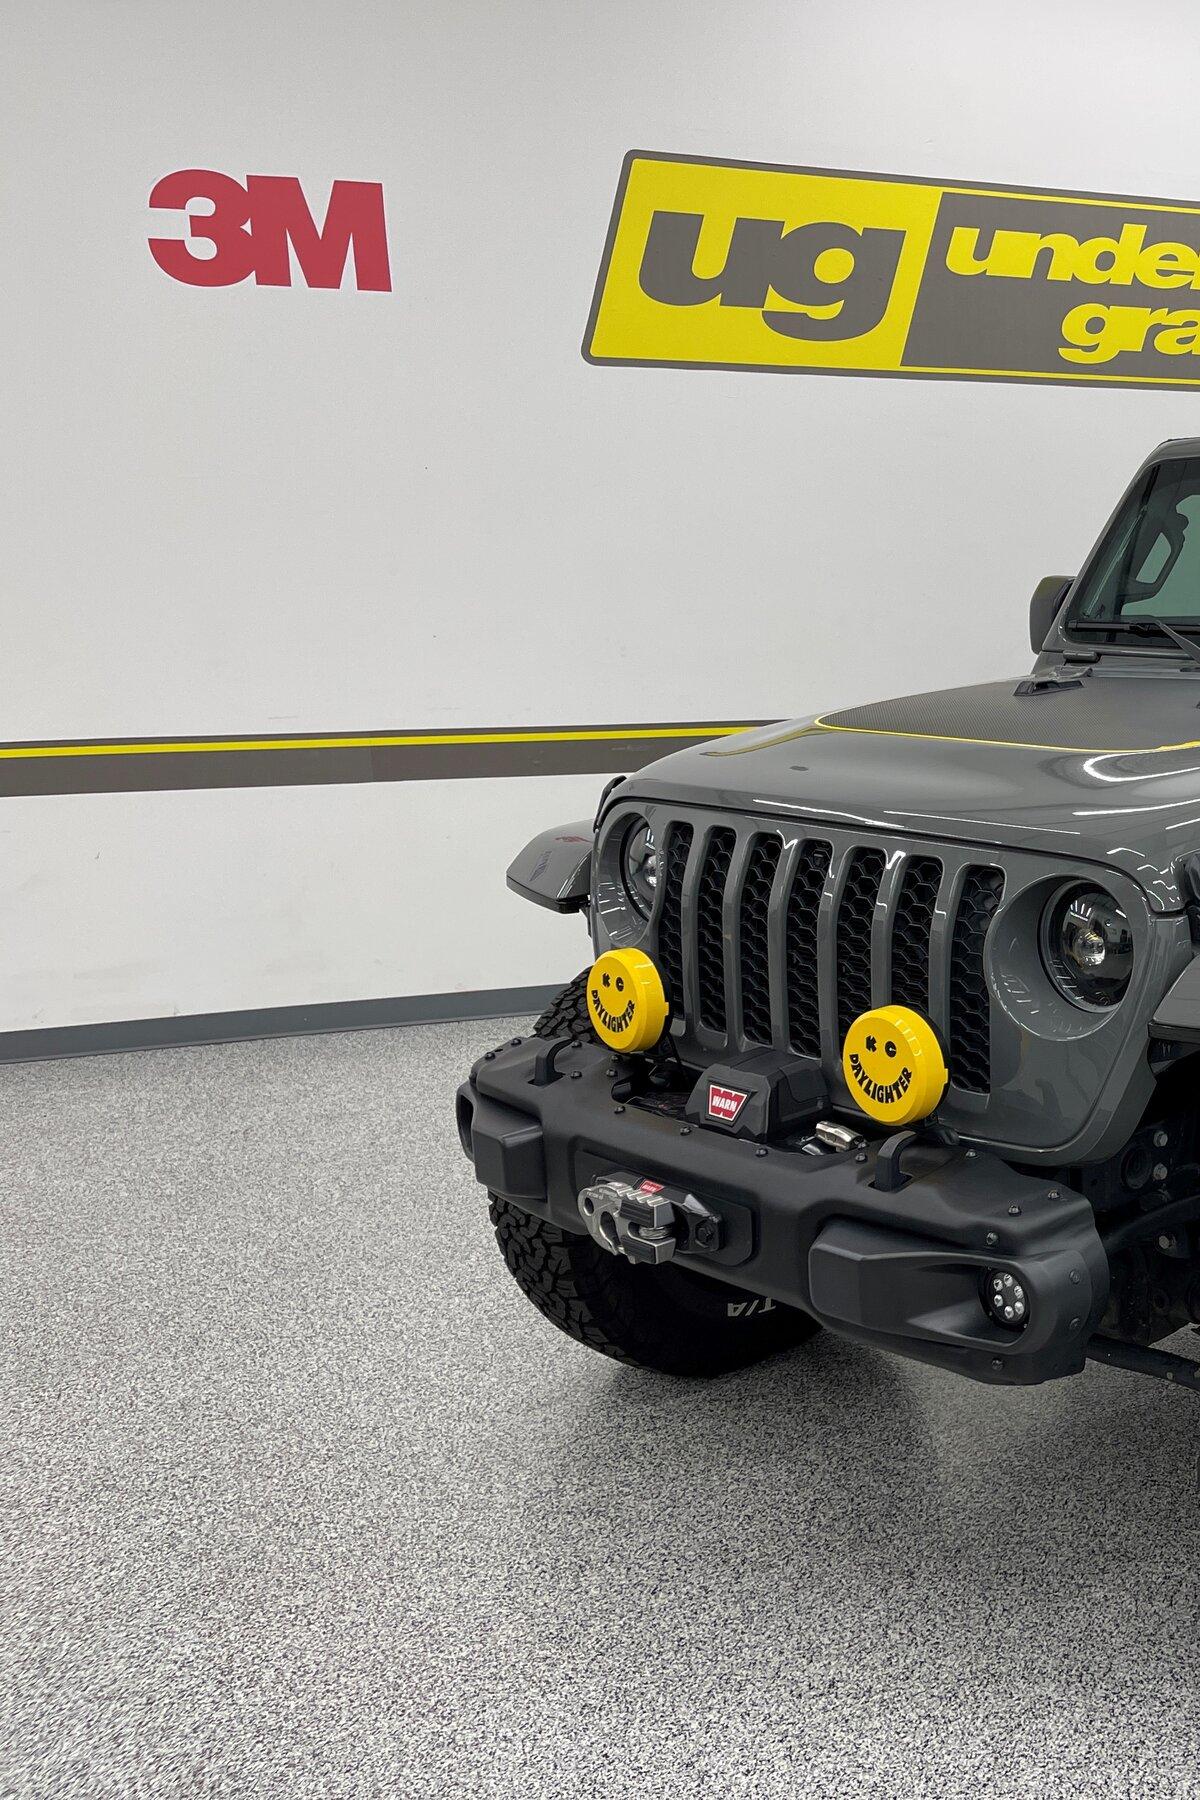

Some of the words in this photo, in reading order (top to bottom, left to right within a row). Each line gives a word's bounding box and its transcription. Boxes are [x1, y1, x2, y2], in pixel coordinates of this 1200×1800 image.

[147, 168, 393, 293] 3M
[638, 209, 906, 343] ug
[590, 989, 636, 1034] DAYLIGHTER
[848, 1053, 913, 1104] DAYLIGHTER
[712, 1095, 738, 1112] WARN
[727, 1297, 777, 1317] T/A
